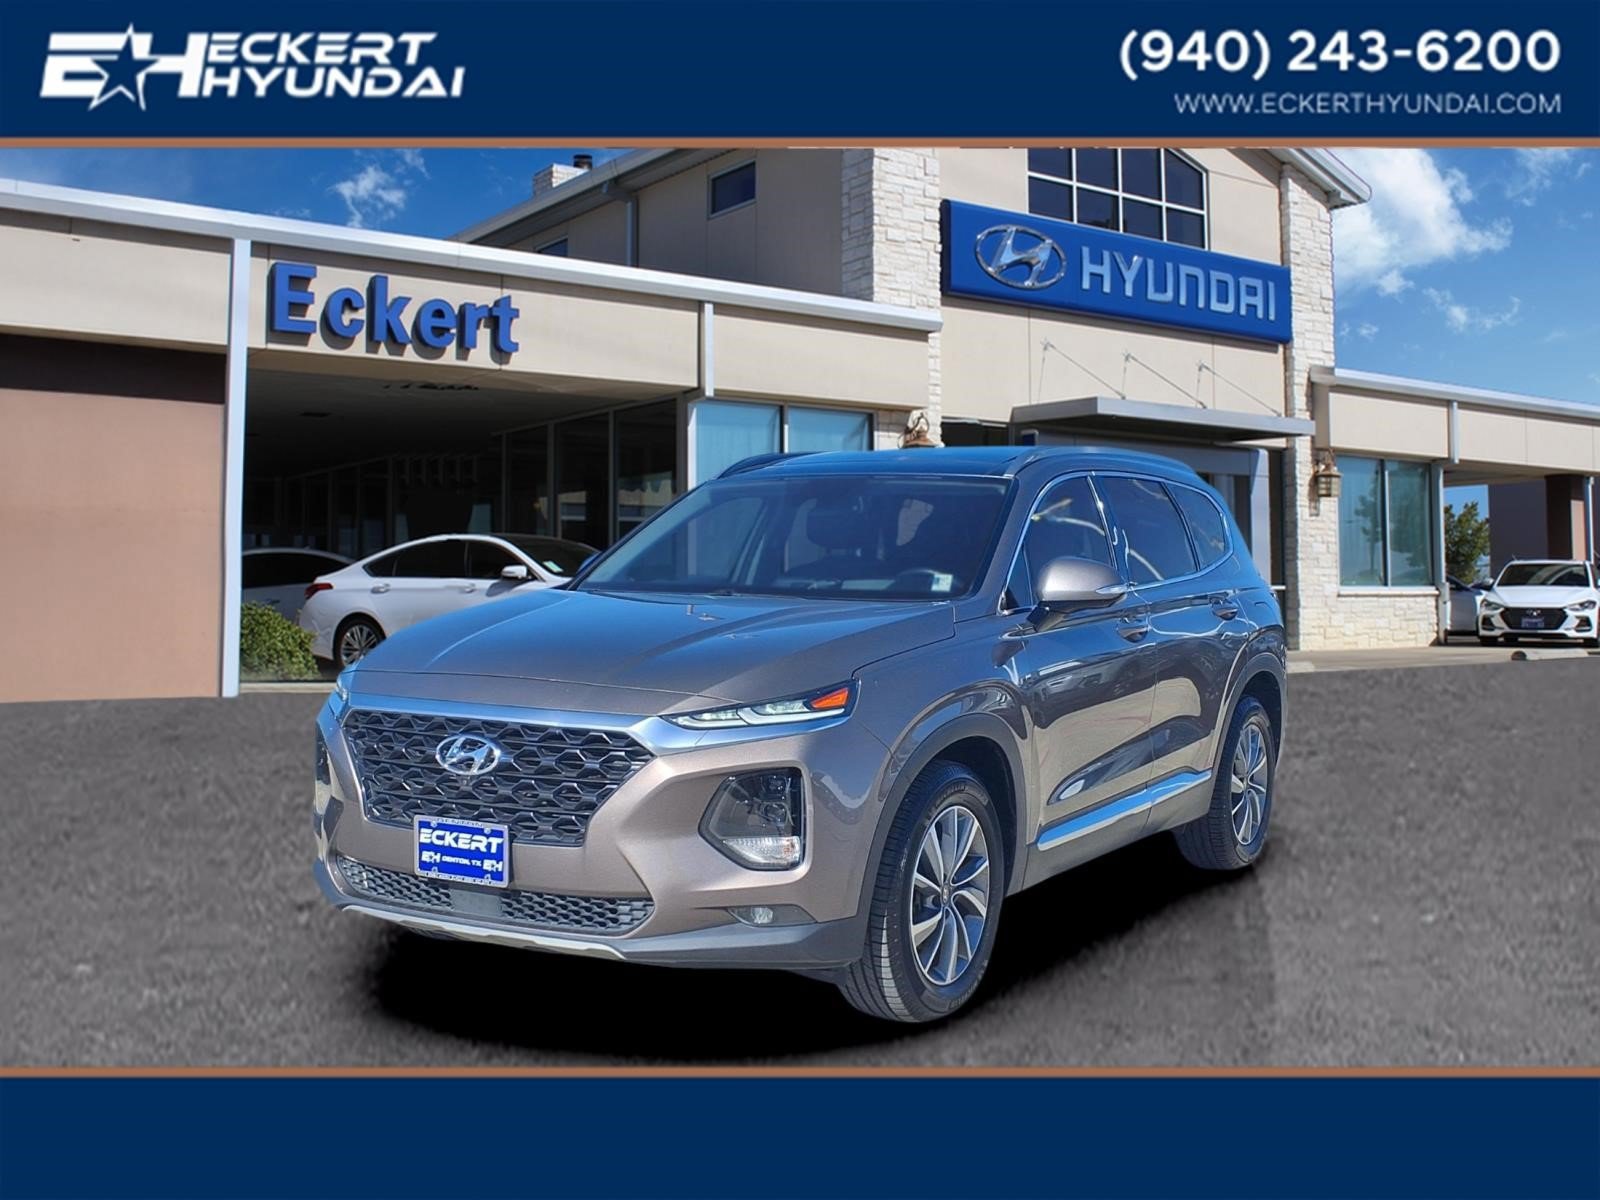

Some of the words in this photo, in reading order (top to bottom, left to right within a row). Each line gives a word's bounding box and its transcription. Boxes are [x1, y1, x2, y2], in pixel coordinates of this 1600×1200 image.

[268, 261, 520, 354] Eckert
[1081, 245, 1276, 321] HYUNDAI
[420, 828, 504, 853] ECKERT
